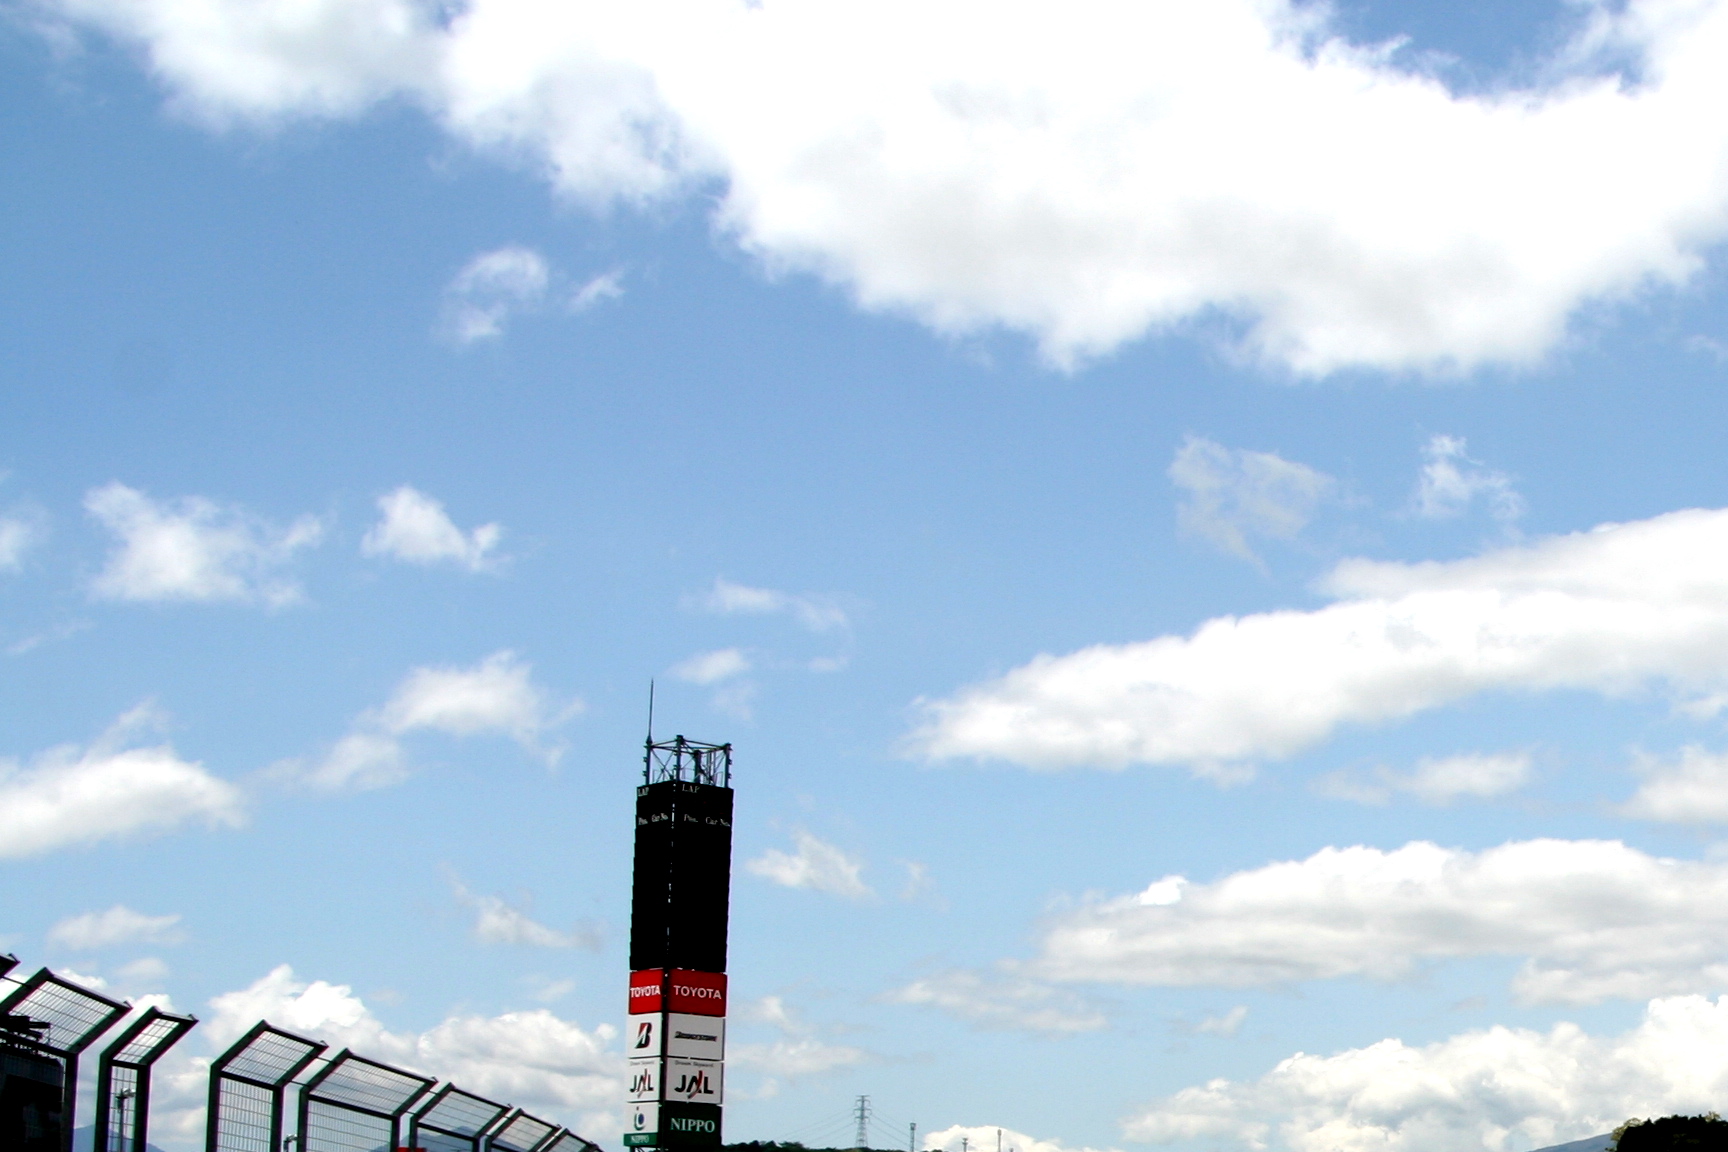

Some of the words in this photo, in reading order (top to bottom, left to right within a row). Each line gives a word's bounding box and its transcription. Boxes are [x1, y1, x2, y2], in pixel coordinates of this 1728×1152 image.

[682, 784, 700, 794] LAP
[630, 985, 661, 998] TOYOTA
[673, 985, 722, 1000] TOYOTA
[630, 1070, 654, 1097] JAL
[674, 1070, 714, 1098] JAL
[670, 1117, 715, 1133] NIPPO
